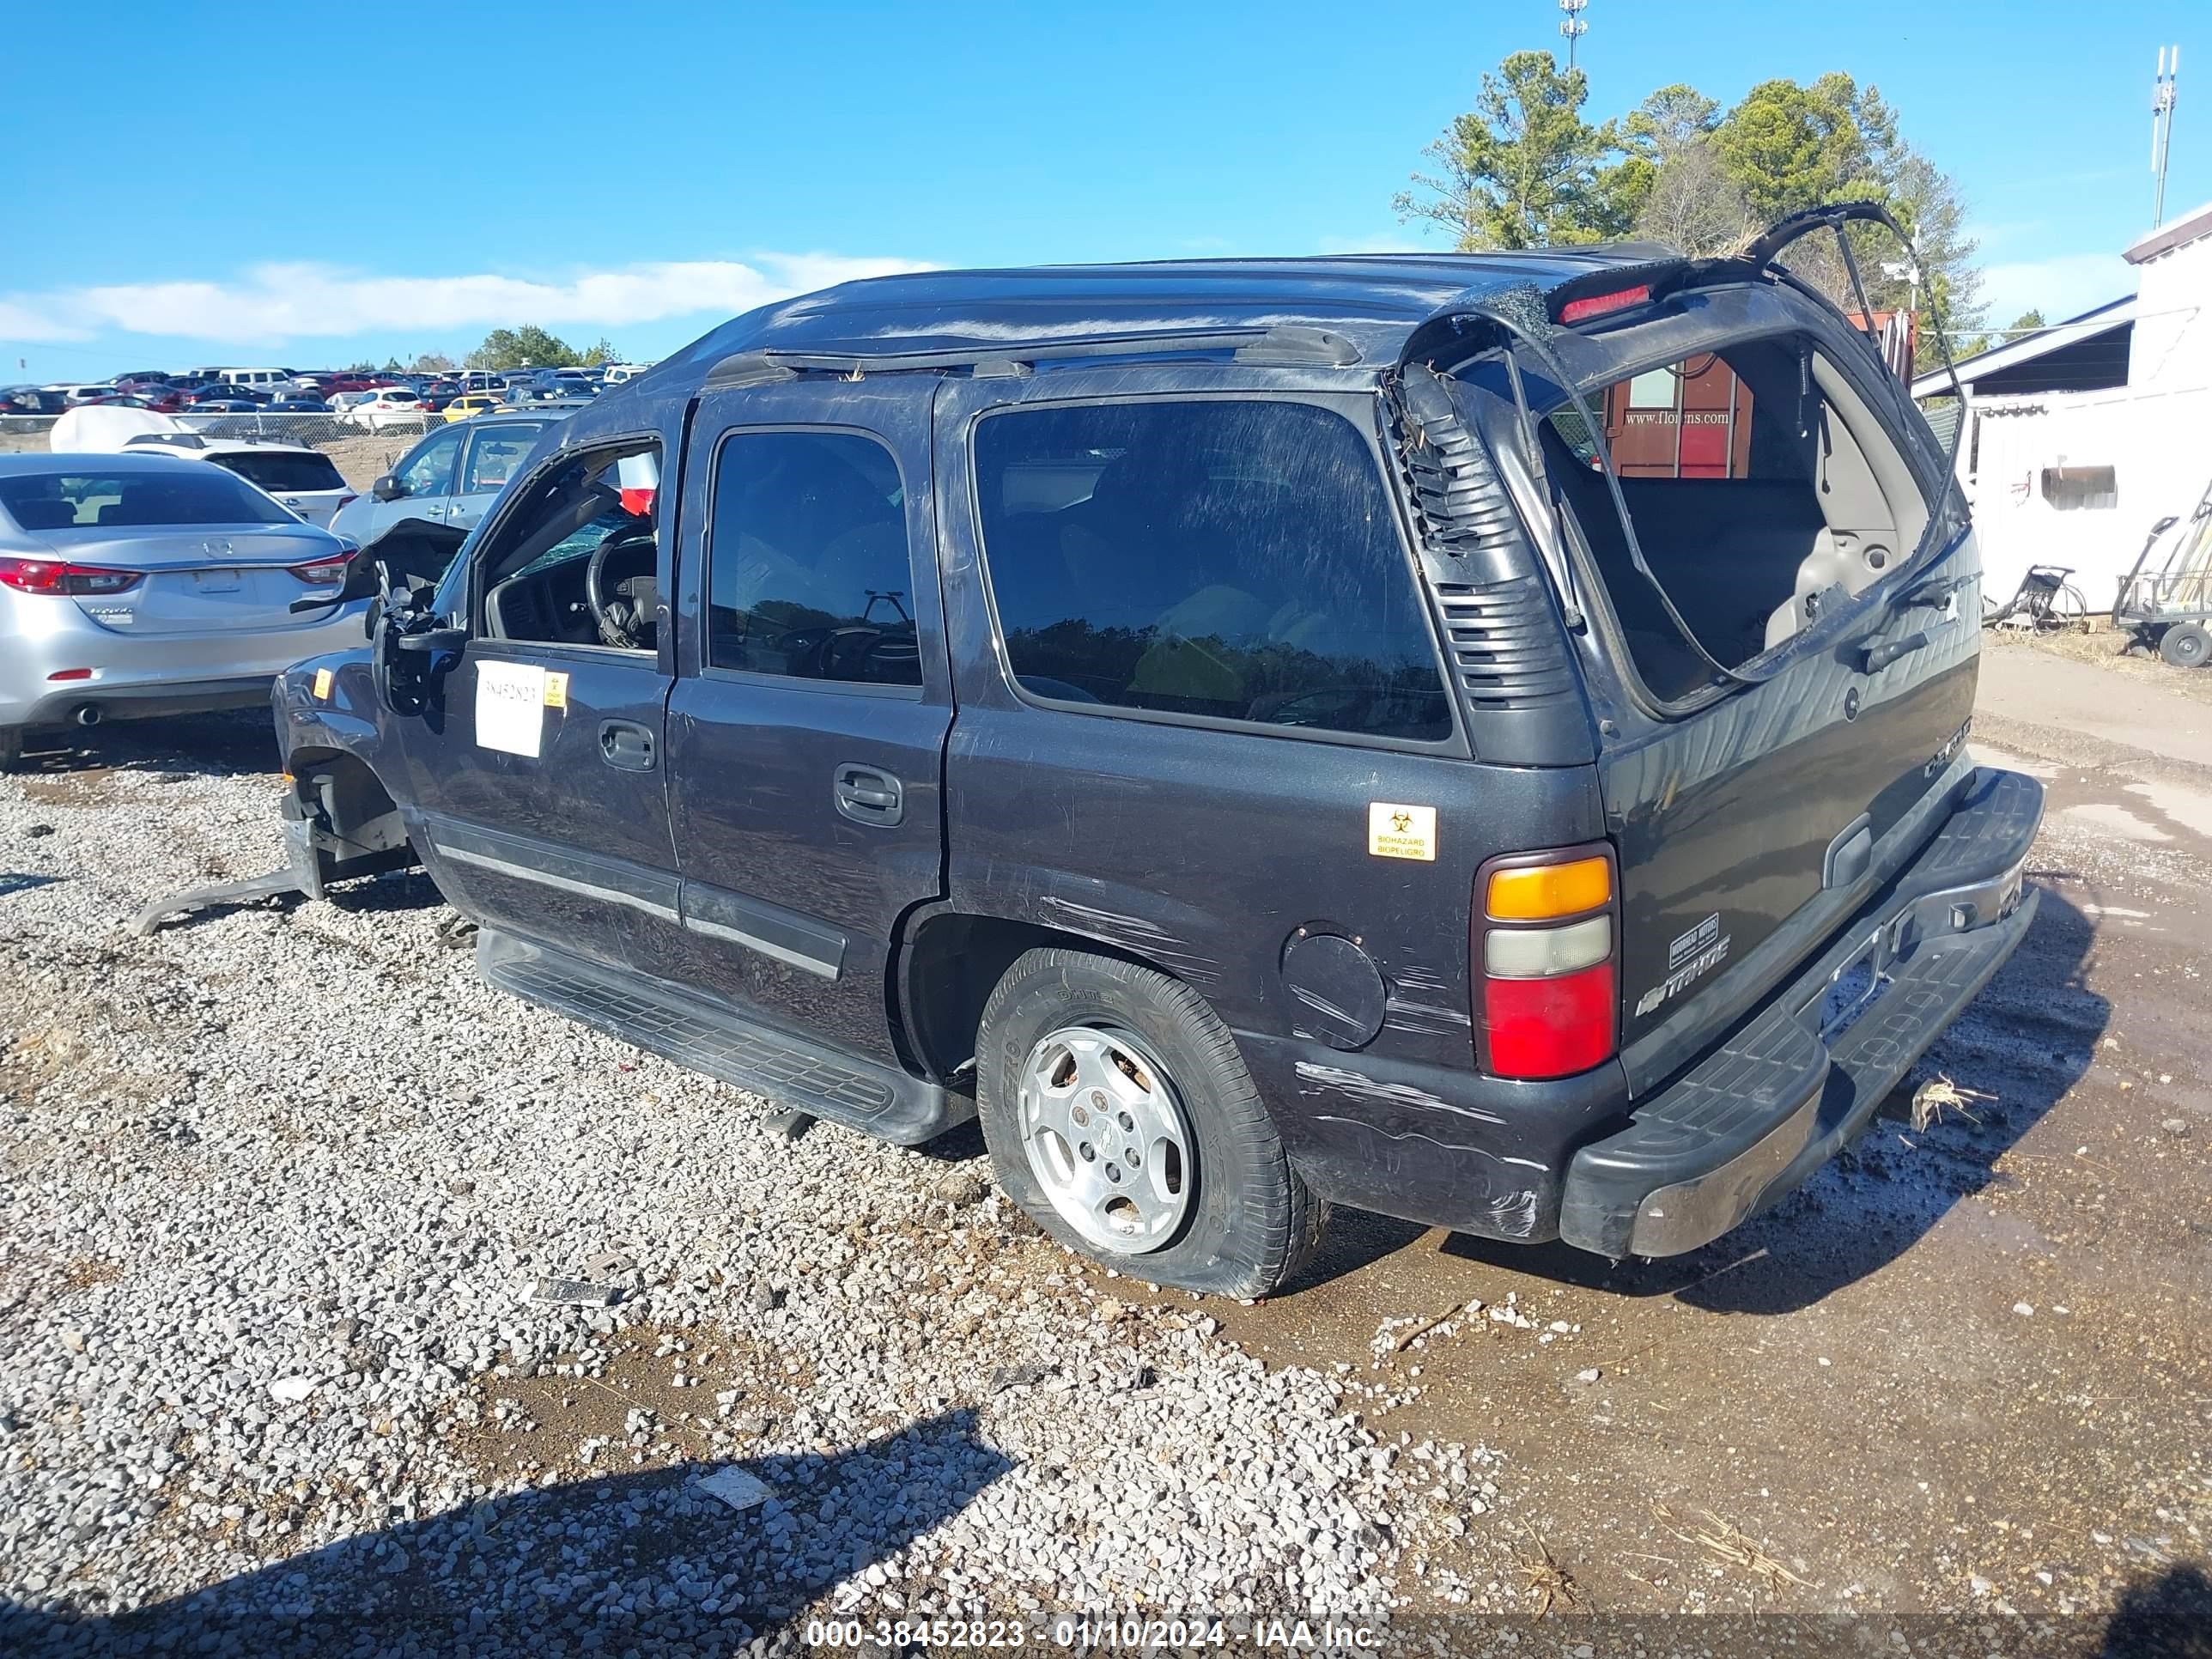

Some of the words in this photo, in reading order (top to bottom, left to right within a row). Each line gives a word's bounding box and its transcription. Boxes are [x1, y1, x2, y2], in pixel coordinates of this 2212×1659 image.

[1626, 410, 1729, 425] www.florns.com
[1377, 836, 1425, 847] BIOHAZARD
[1377, 846, 1425, 856] BIOPELIGRO
[1698, 918, 1717, 939] MOTORS
[1668, 934, 1731, 998] TAHOE
